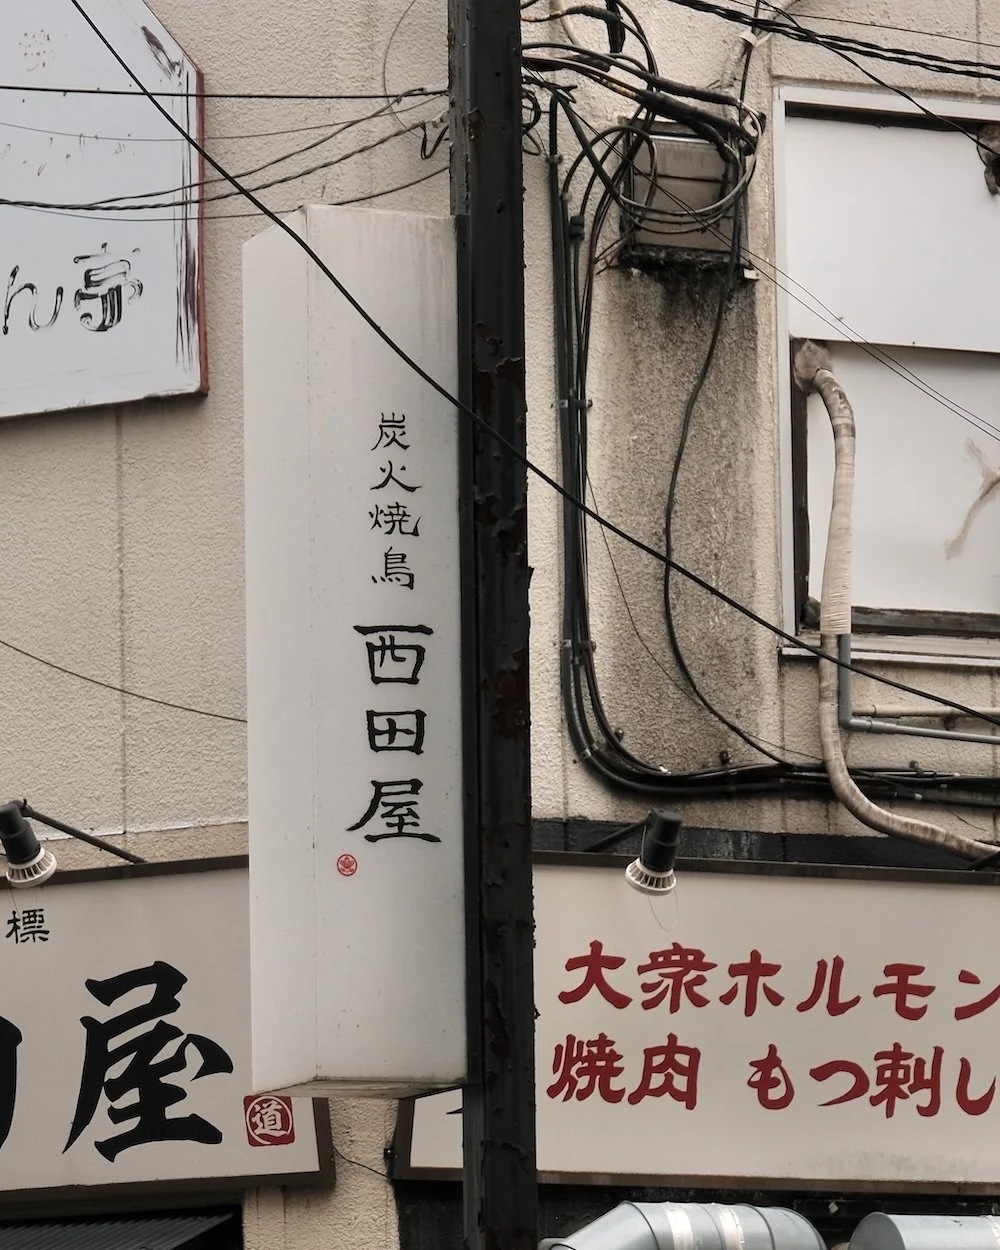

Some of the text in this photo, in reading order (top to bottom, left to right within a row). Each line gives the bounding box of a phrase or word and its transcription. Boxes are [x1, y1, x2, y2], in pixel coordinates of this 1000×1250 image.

[367, 412, 422, 590] 炭火焼鳥
[346, 624, 441, 843] 西田屋
[557, 939, 1000, 1021] 大衆ホルモン
[546, 1032, 997, 1119] 焼肉 もつ刺し
